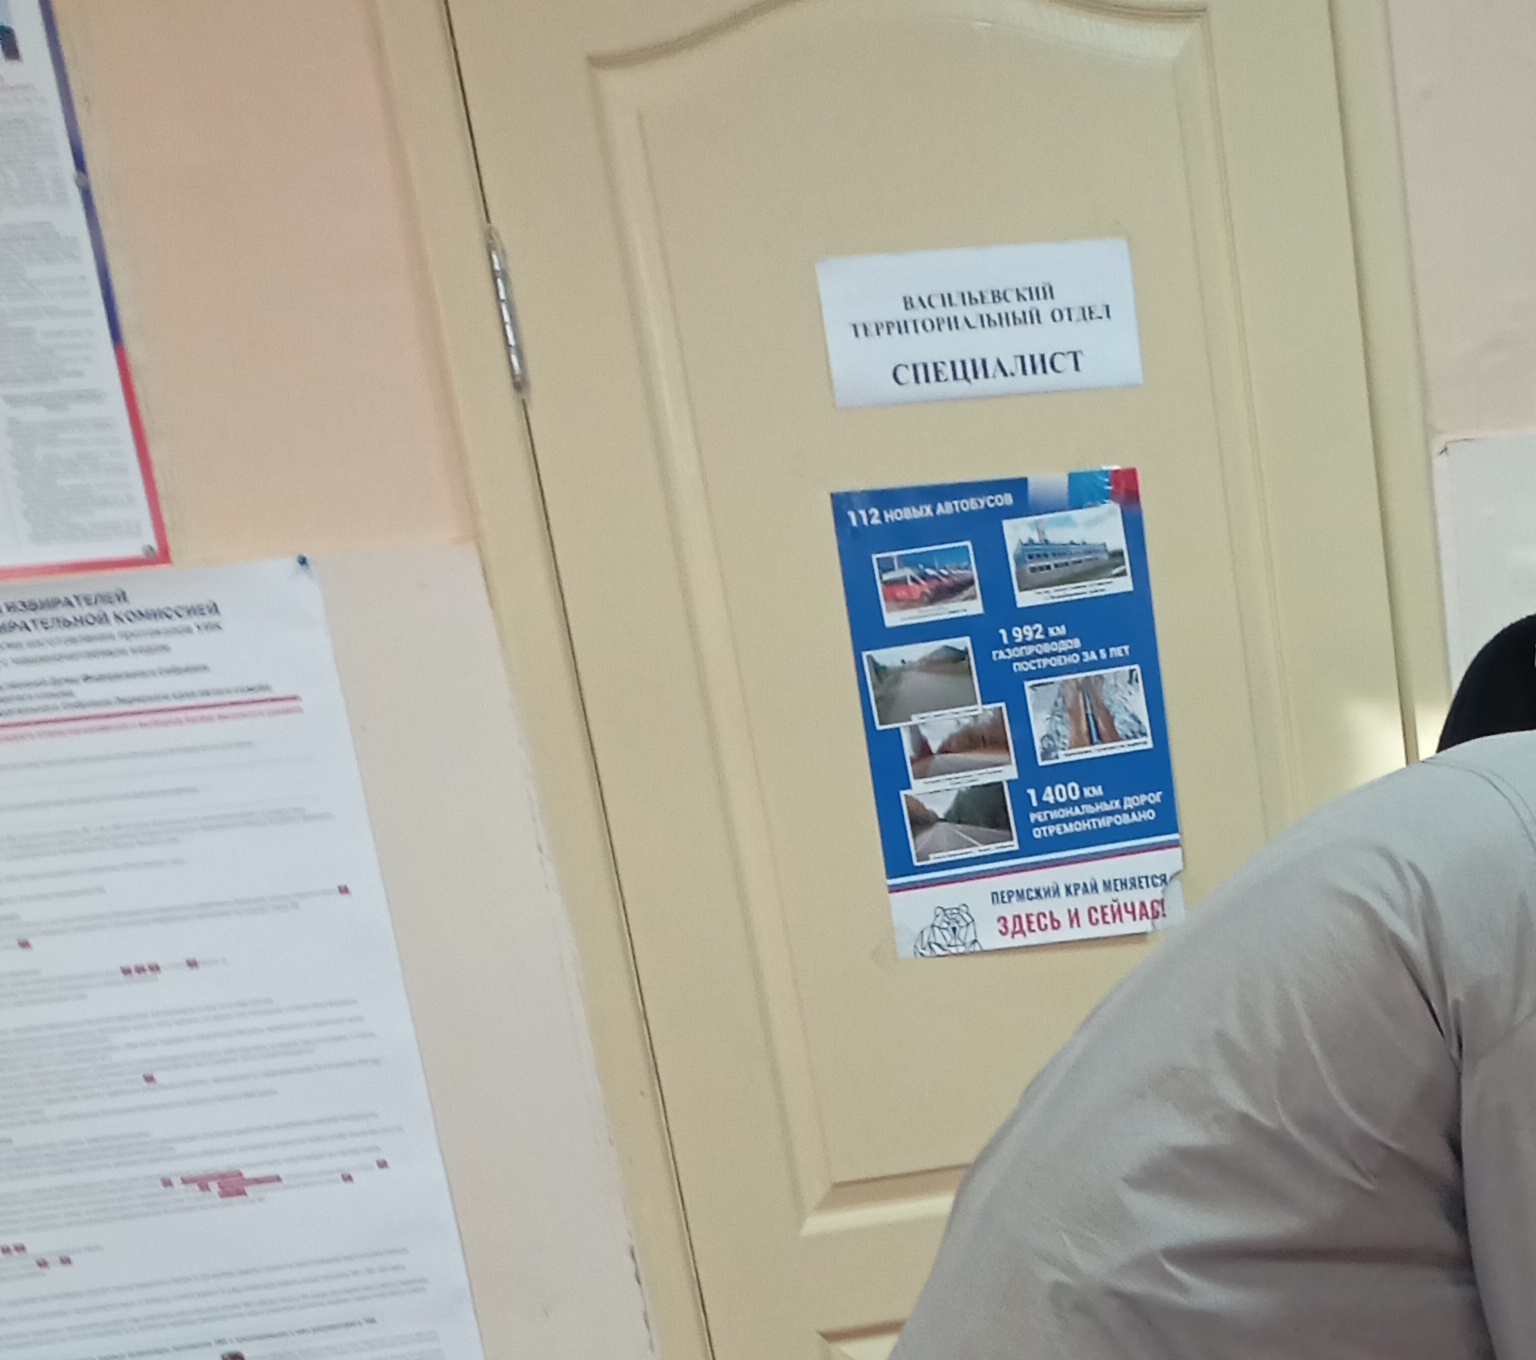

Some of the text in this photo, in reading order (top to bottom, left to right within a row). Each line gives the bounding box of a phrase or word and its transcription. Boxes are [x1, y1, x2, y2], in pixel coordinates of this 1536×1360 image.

[902, 282, 1055, 311] ВАСИЛЬЕВСКИЙ
[850, 304, 1112, 338] ТЕРРИТОРИАЛЬНЫЙ ОТДЕЛ
[892, 349, 1084, 386] СПЕЦИАЛИСТ
[847, 492, 1013, 527] 112 НОВЫХ АВТОБУСОВ
[991, 638, 1081, 661] ГАЗОПРОВОДОВ
[1013, 653, 1080, 672] ПОСТРОЕНО
[1082, 651, 1098, 662] ЗА
[1109, 645, 1130, 658] ЛЕТ
[1029, 791, 1163, 823] РЕГИОНАЛЬНЫХ ДОРОГ
[1032, 809, 1156, 838] ОТРЕМОНТИРОВАНО
[991, 873, 1168, 905] ПЕРМСКИЙ КРАЙ МЕНЯЕТСЯ
[997, 898, 1167, 938] ЗДЕСЬ И СЕЙЧАС!
